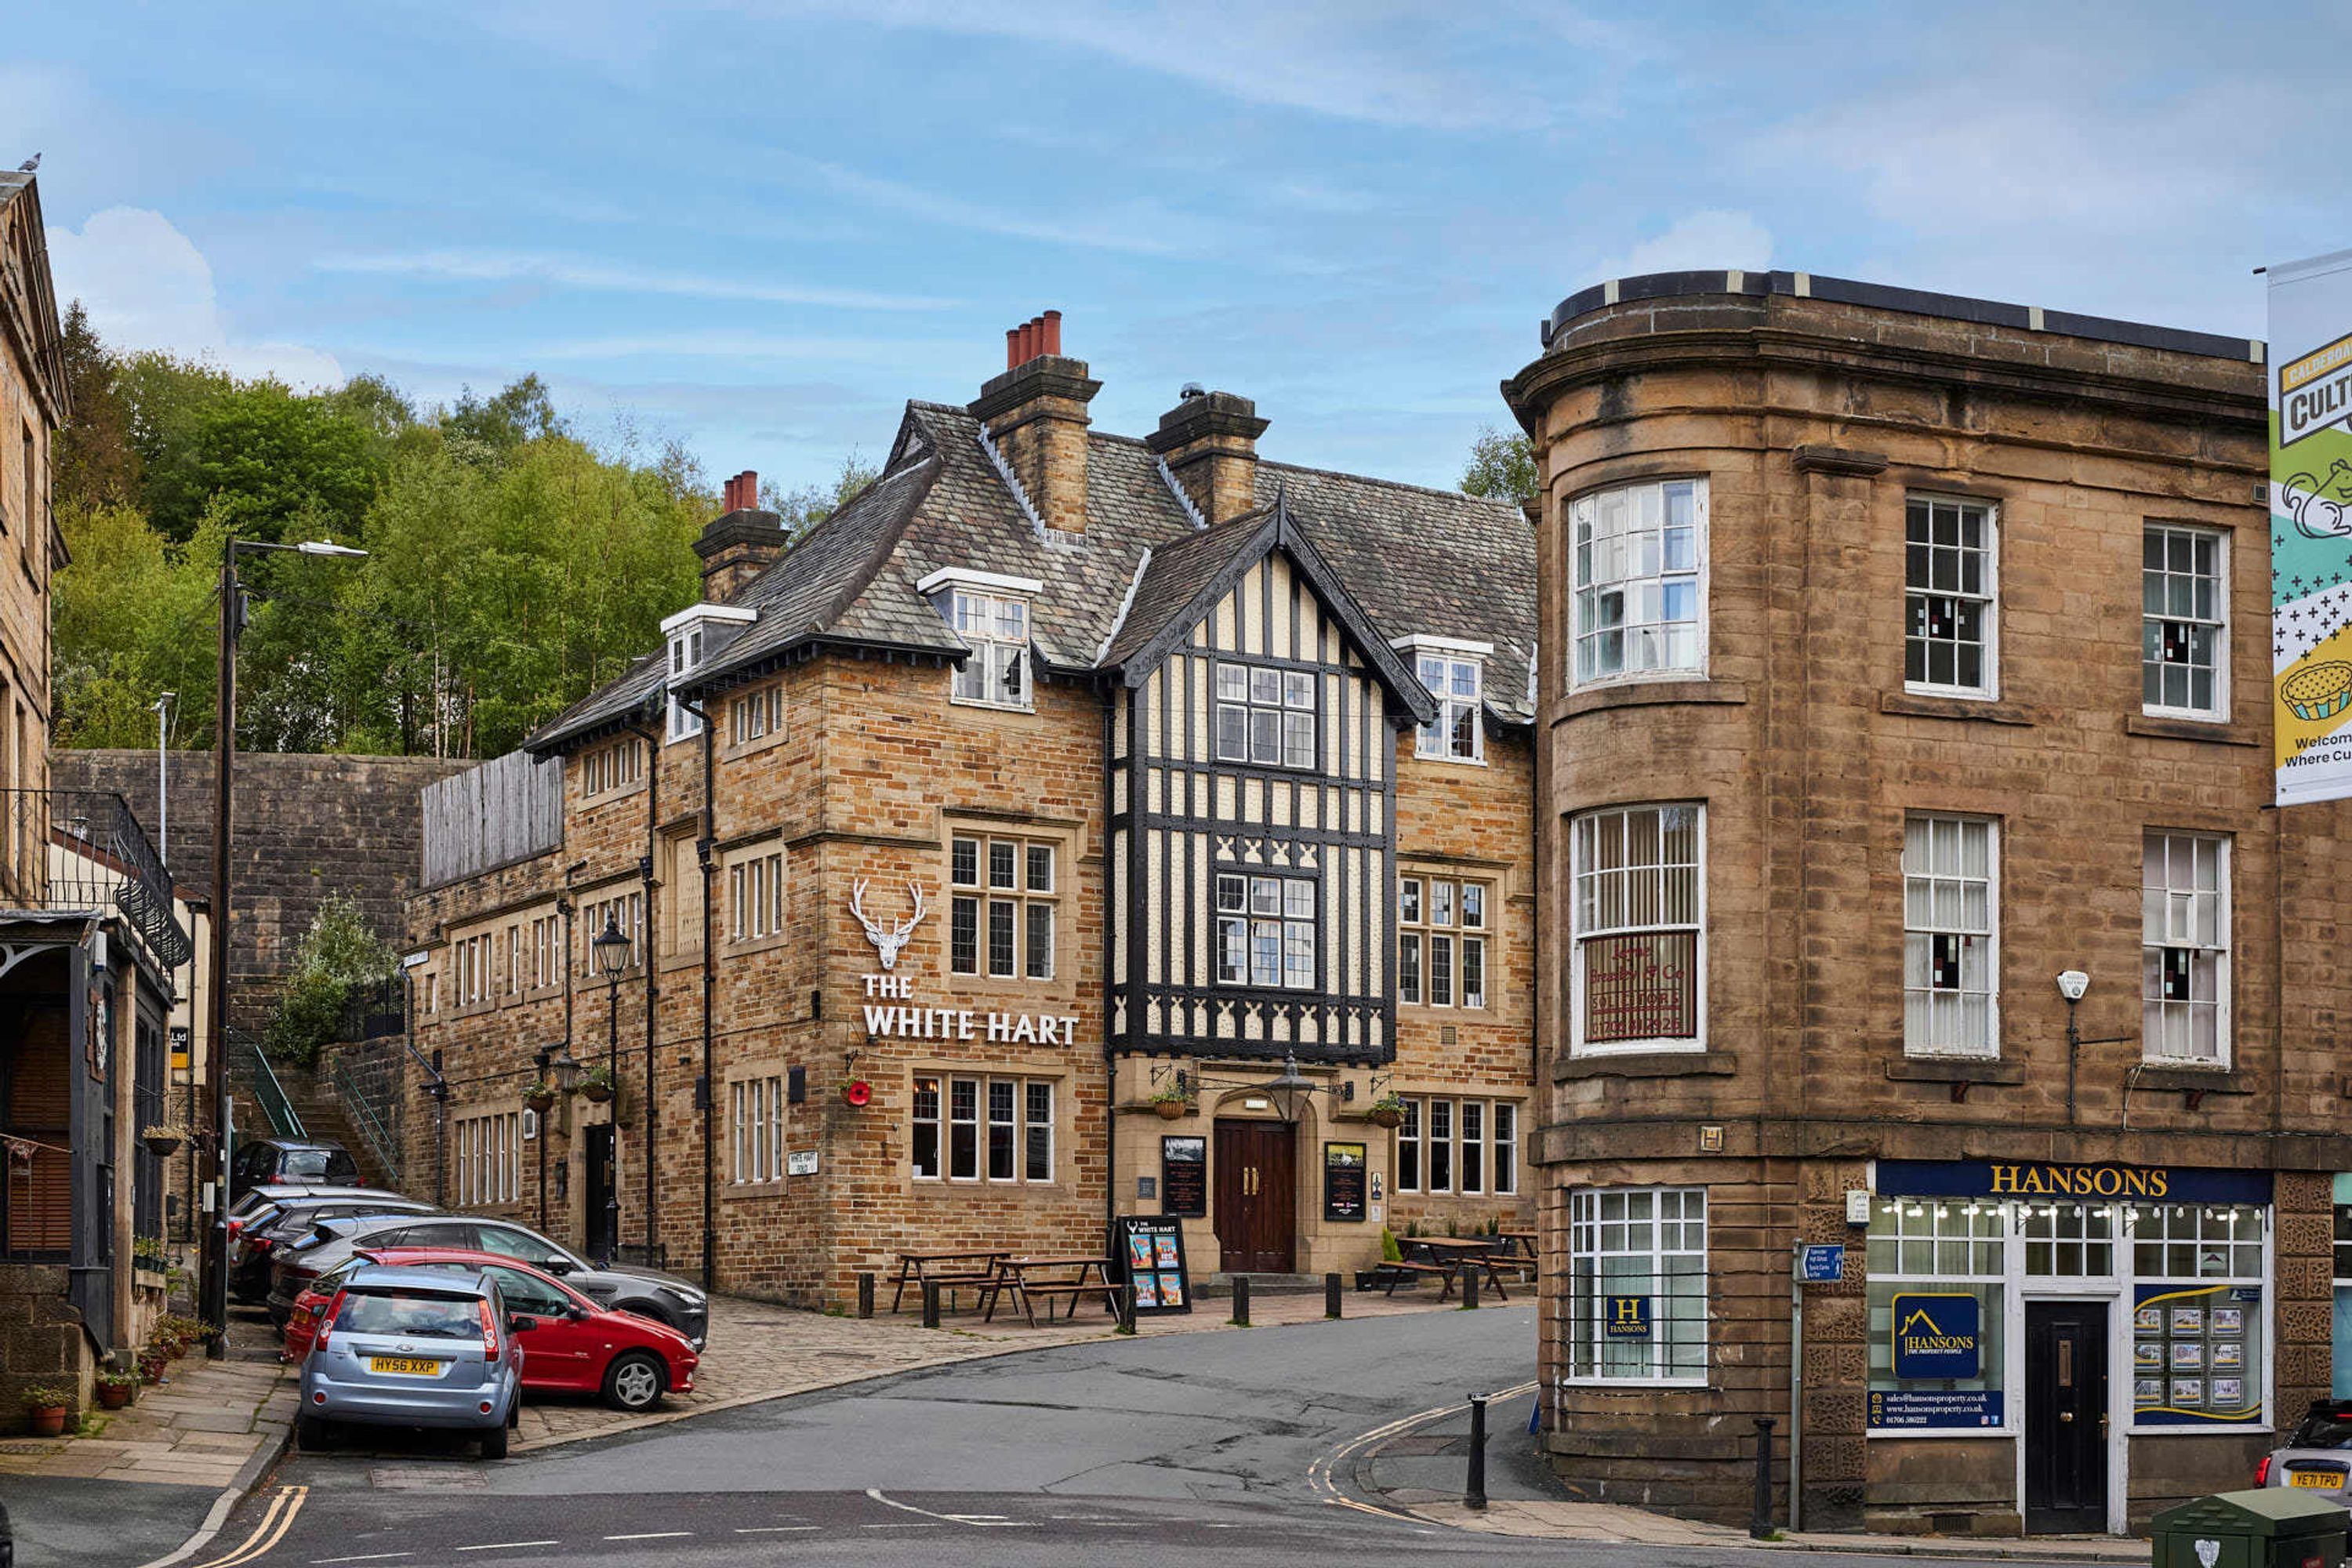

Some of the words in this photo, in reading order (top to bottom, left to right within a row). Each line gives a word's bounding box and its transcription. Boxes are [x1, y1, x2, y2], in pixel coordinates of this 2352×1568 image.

[2291, 373, 2352, 431] CULT
[2285, 753, 2330, 768] Where
[862, 975, 913, 998] THE
[862, 1005, 975, 1040] WHITE
[987, 1012, 1080, 1045] HART
[1990, 1166, 2168, 1197] HANSONS
[1616, 1299, 1640, 1324] H
[1908, 1336, 1974, 1349] HANSONS
[376, 1358, 407, 1370] HY56
[410, 1359, 434, 1373] XXP
